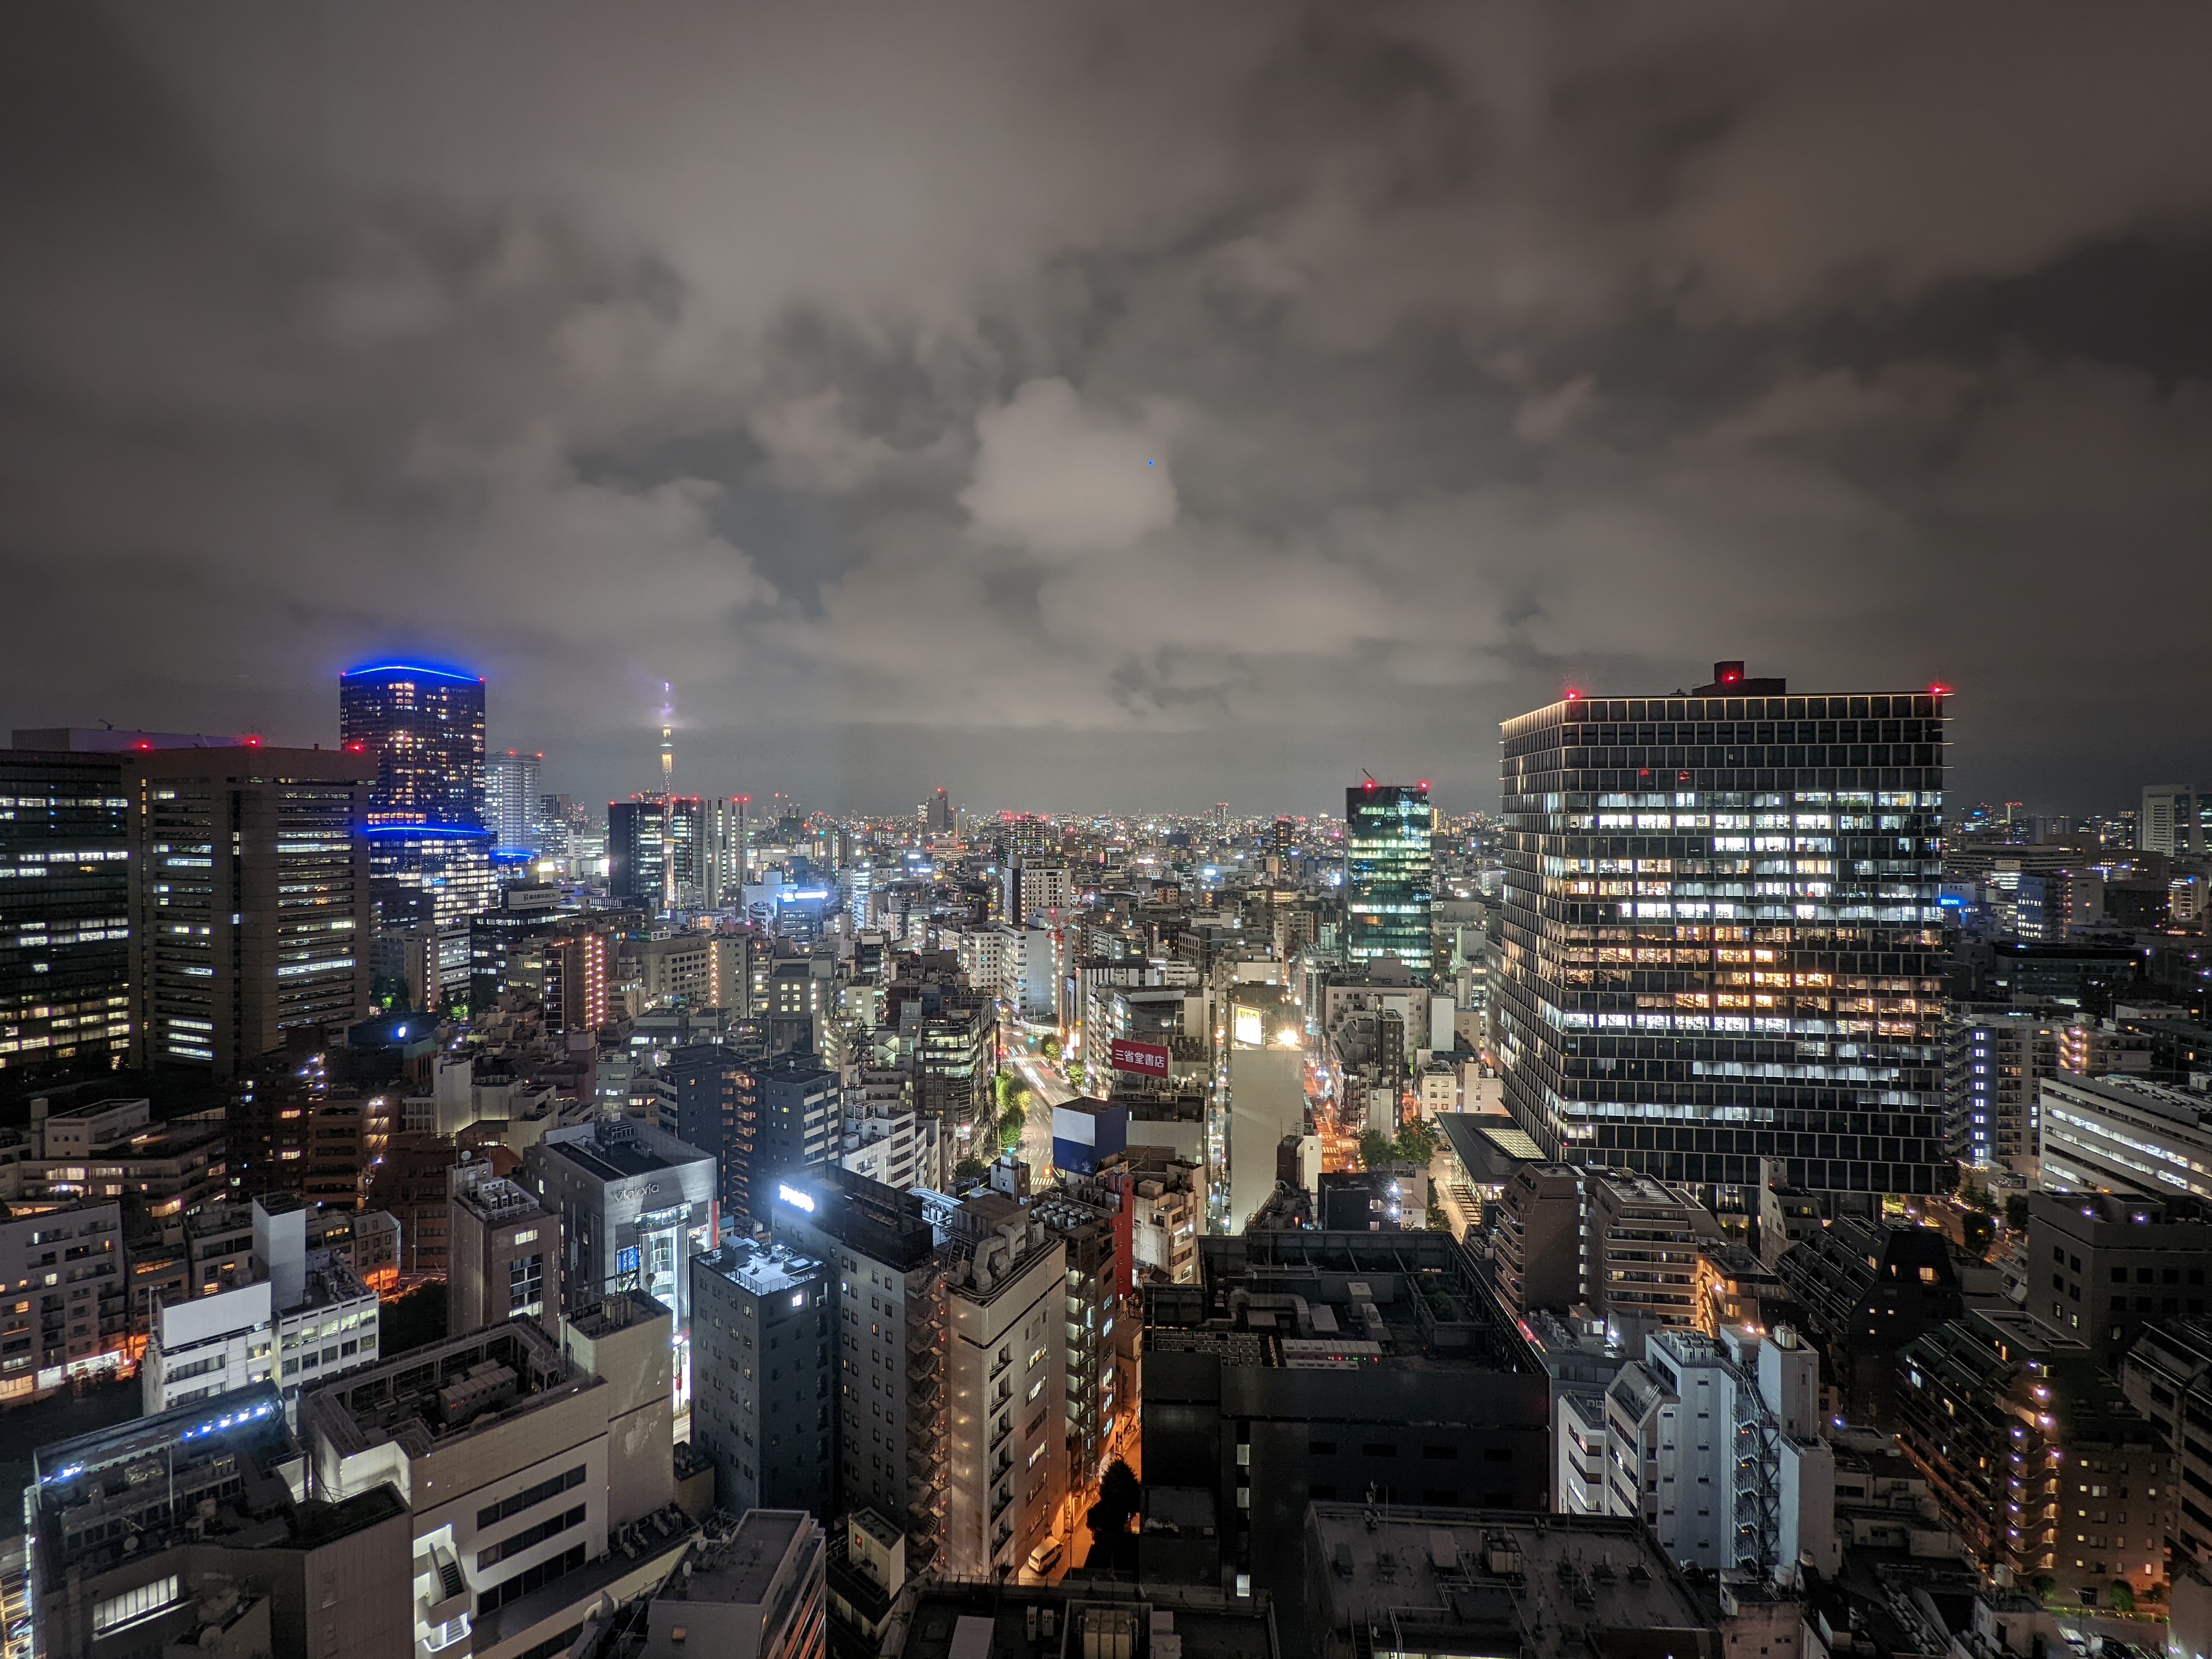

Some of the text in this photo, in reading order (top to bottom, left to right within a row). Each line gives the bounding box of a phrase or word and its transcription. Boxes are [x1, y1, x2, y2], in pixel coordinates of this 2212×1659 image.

[1115, 1049, 1165, 1068] 三省堂書店
